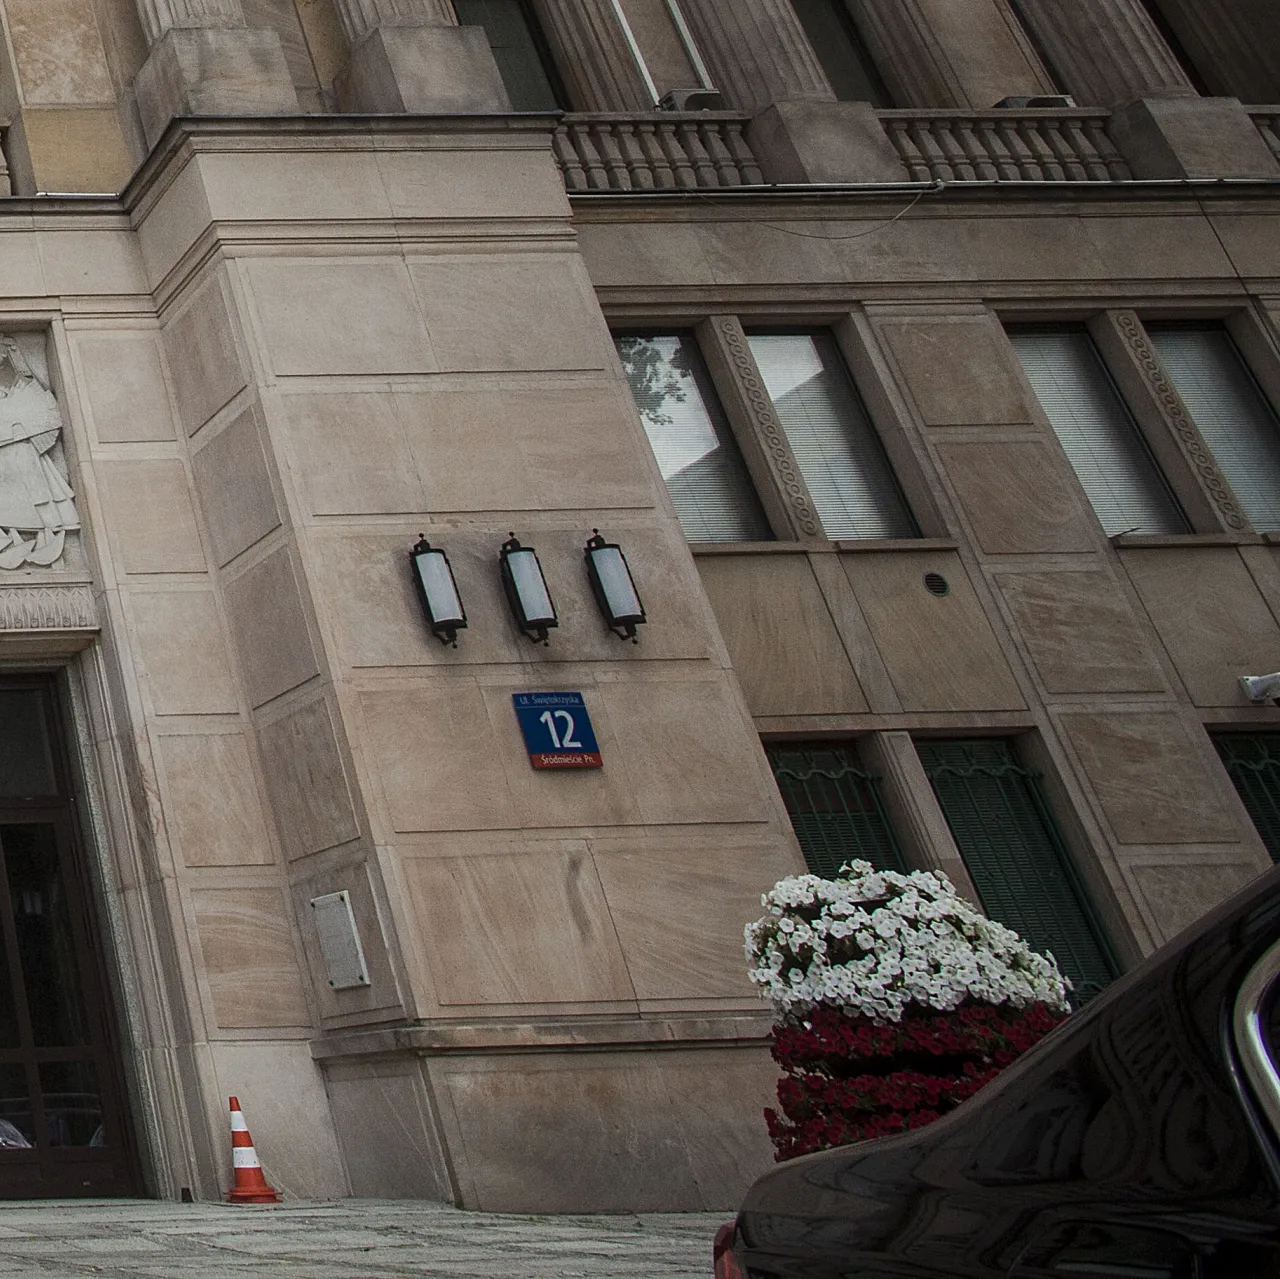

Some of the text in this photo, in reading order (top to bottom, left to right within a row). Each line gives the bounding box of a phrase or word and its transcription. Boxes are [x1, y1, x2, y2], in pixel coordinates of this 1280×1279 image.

[539, 710, 582, 748] 12
[541, 754, 596, 765] Śródmieście Pn.
